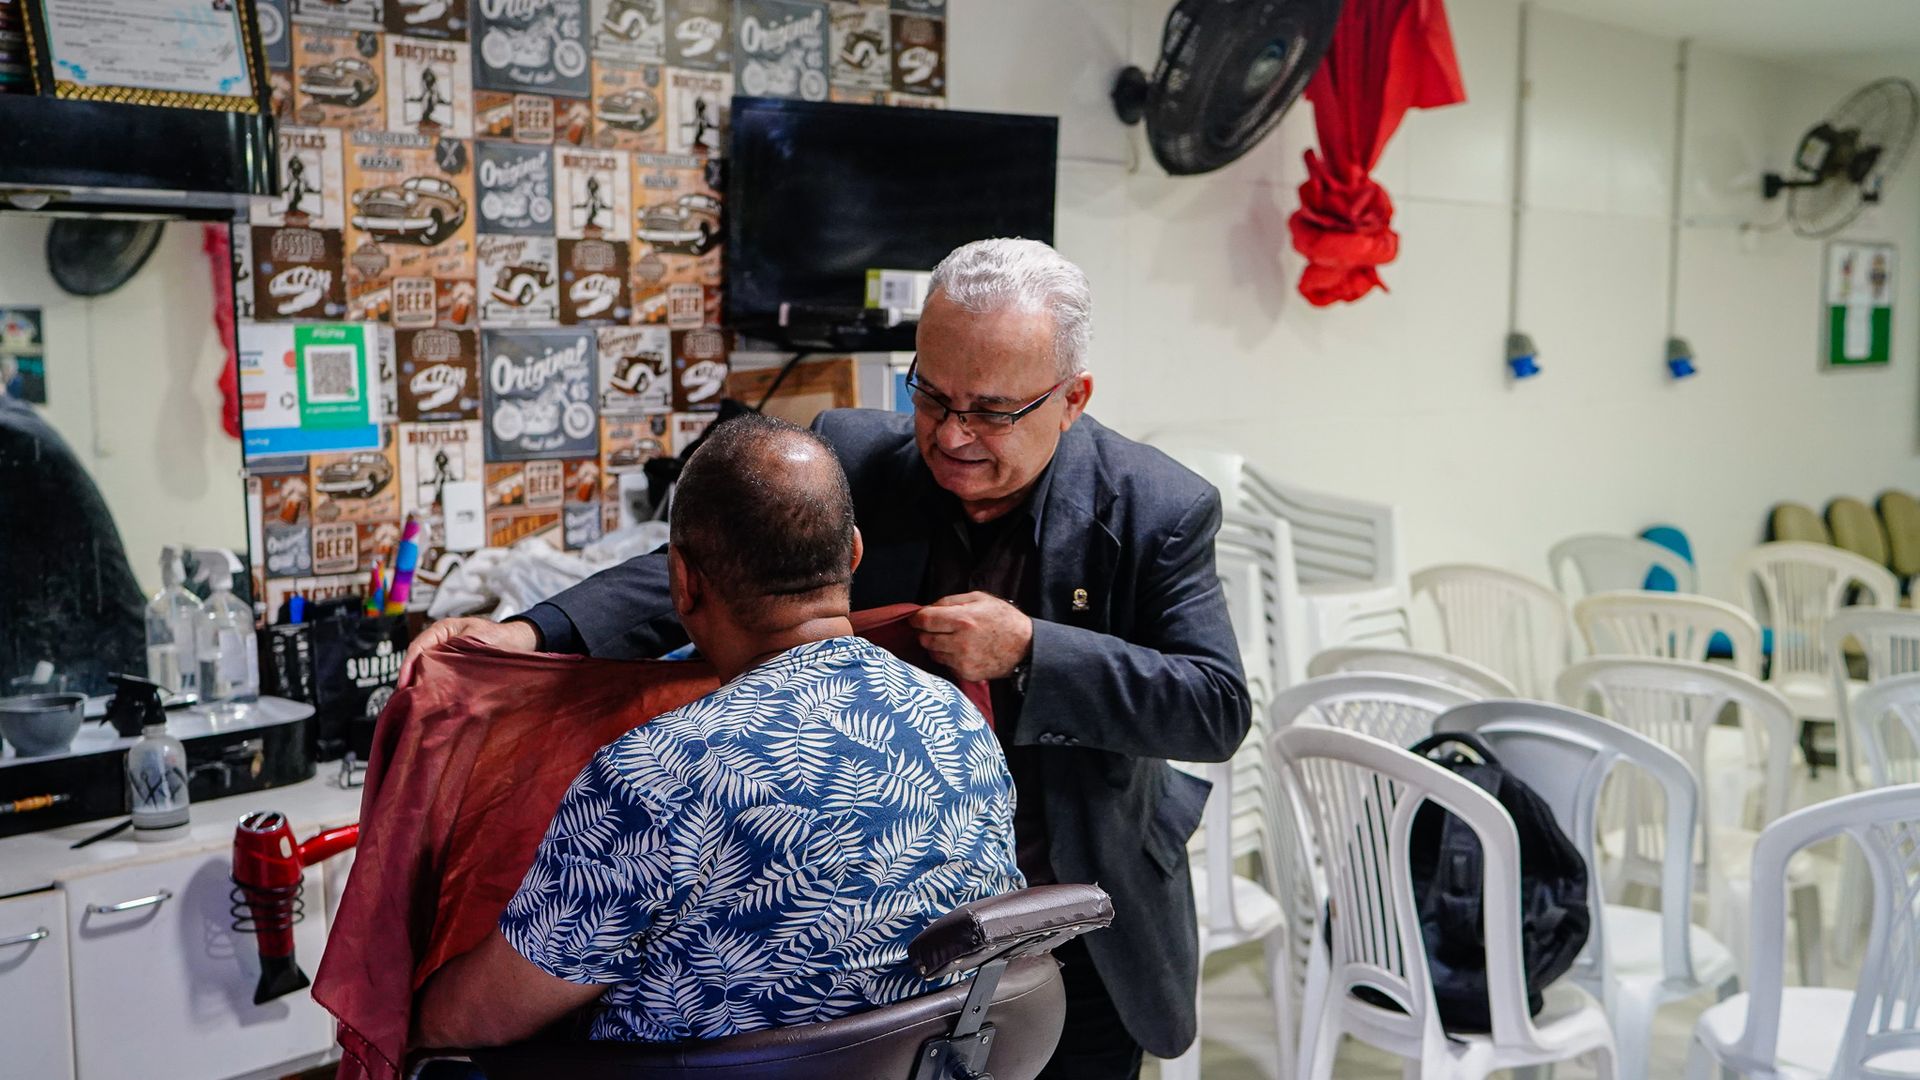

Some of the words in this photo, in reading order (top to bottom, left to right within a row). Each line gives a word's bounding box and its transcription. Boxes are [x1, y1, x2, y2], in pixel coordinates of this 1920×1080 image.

[394, 43, 457, 64] BICYCLES
[397, 292, 432, 312] BEER
[490, 336, 589, 396] Original
[408, 429, 469, 446] BICYCLES
[316, 537, 353, 560] BEER
